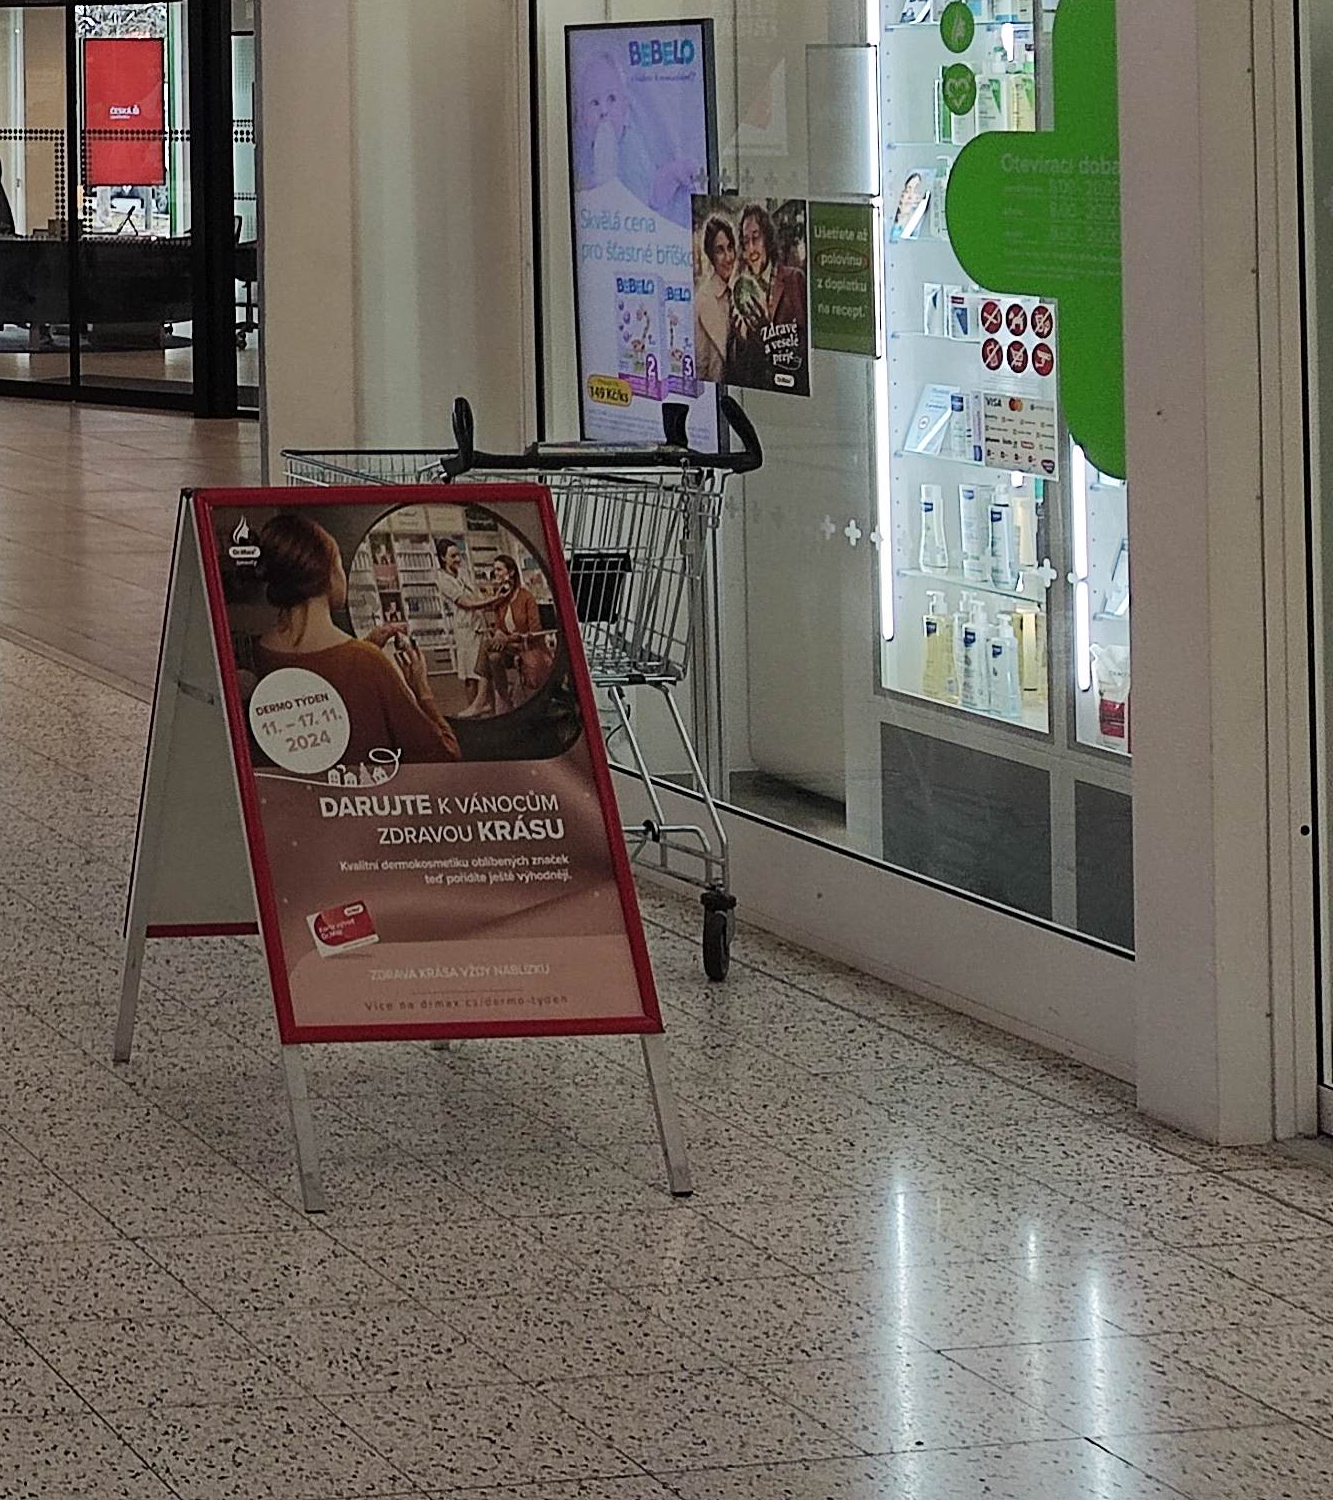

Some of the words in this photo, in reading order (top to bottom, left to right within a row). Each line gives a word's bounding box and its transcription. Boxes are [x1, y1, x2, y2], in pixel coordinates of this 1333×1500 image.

[624, 215, 657, 233] cena
[581, 243, 603, 263] pro
[820, 252, 862, 267] polovinu
[825, 278, 867, 292] doplatku
[818, 303, 830, 314] na
[760, 318, 798, 341] Zdravé
[771, 333, 799, 350] veselé
[255, 700, 293, 716] DERMO
[262, 721, 282, 735] 11.
[286, 730, 331, 752] 2024
[320, 794, 433, 818] DARUJTE
[438, 797, 452, 814] K
[455, 790, 559, 814] VÁNOCŮM
[377, 825, 473, 845] ZDRAVOU
[477, 815, 565, 842] KRÁSU
[340, 858, 379, 871] Kvalitní
[381, 857, 469, 870] dermokosmetiku
[471, 855, 529, 869] oblíbených
[532, 853, 570, 865] značek
[425, 874, 443, 883] teď
[489, 871, 515, 884] ještě
[400, 1001, 414, 1010] na
